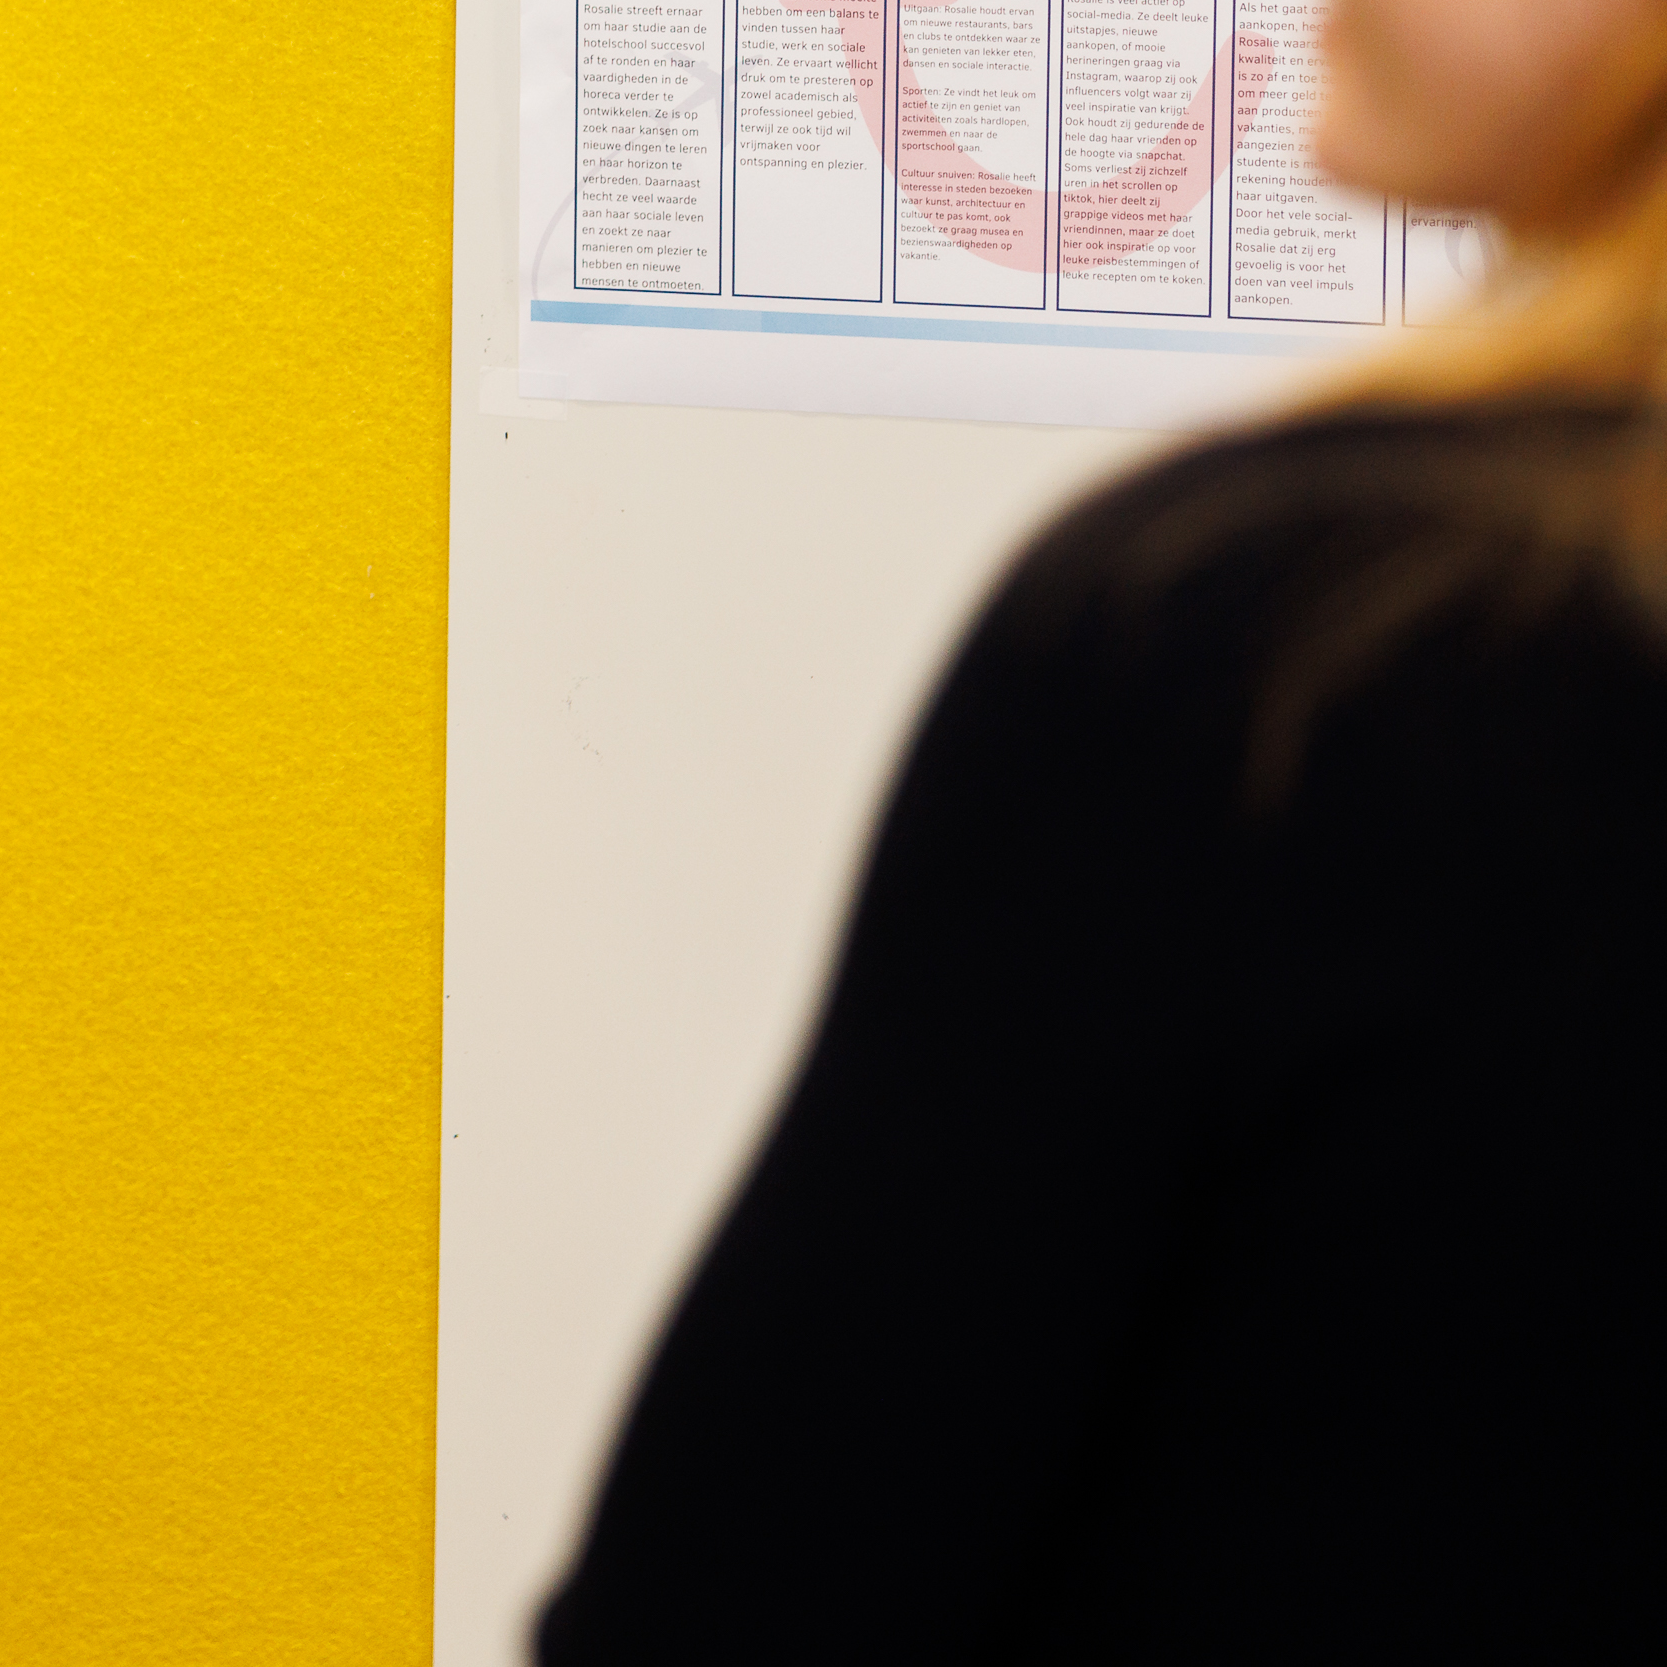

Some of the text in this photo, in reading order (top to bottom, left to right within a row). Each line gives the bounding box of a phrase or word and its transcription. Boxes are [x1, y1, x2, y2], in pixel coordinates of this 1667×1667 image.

[583, 3, 703, 17] Rosalie streeft ernaar
[742, 5, 879, 19] hebben om een balans te
[1066, 8, 1208, 23] social-media. Ze deelt leuke
[583, 21, 707, 34] om haar studie aan de
[741, 22, 845, 35] vinden tussen haar
[1066, 24, 1158, 37] uitstapjes, nieuwe
[583, 37, 704, 51] hotelschool succesvol
[741, 38, 866, 53] studie, werk en sociale
[1066, 39, 1165, 52] aankopen, of mooie
[583, 53, 696, 68] af te ronden en haar
[741, 55, 878, 70] leven. Ze ervaart wellicht
[1066, 55, 1180, 69] herineringen graag via
[582, 71, 688, 86] vaardigheden in de
[740, 71, 873, 88] druk om te presteren op
[583, 88, 674, 102] horeca verder te
[1236, 190, 1317, 206] haar uitgaven.
[1235, 207, 1353, 222] Door het vele social-
[1411, 217, 1477, 231] ervaringen.
[1235, 224, 1356, 240] media gebruik, merkt
[1235, 241, 1336, 258] Rosalie dat zij erg
